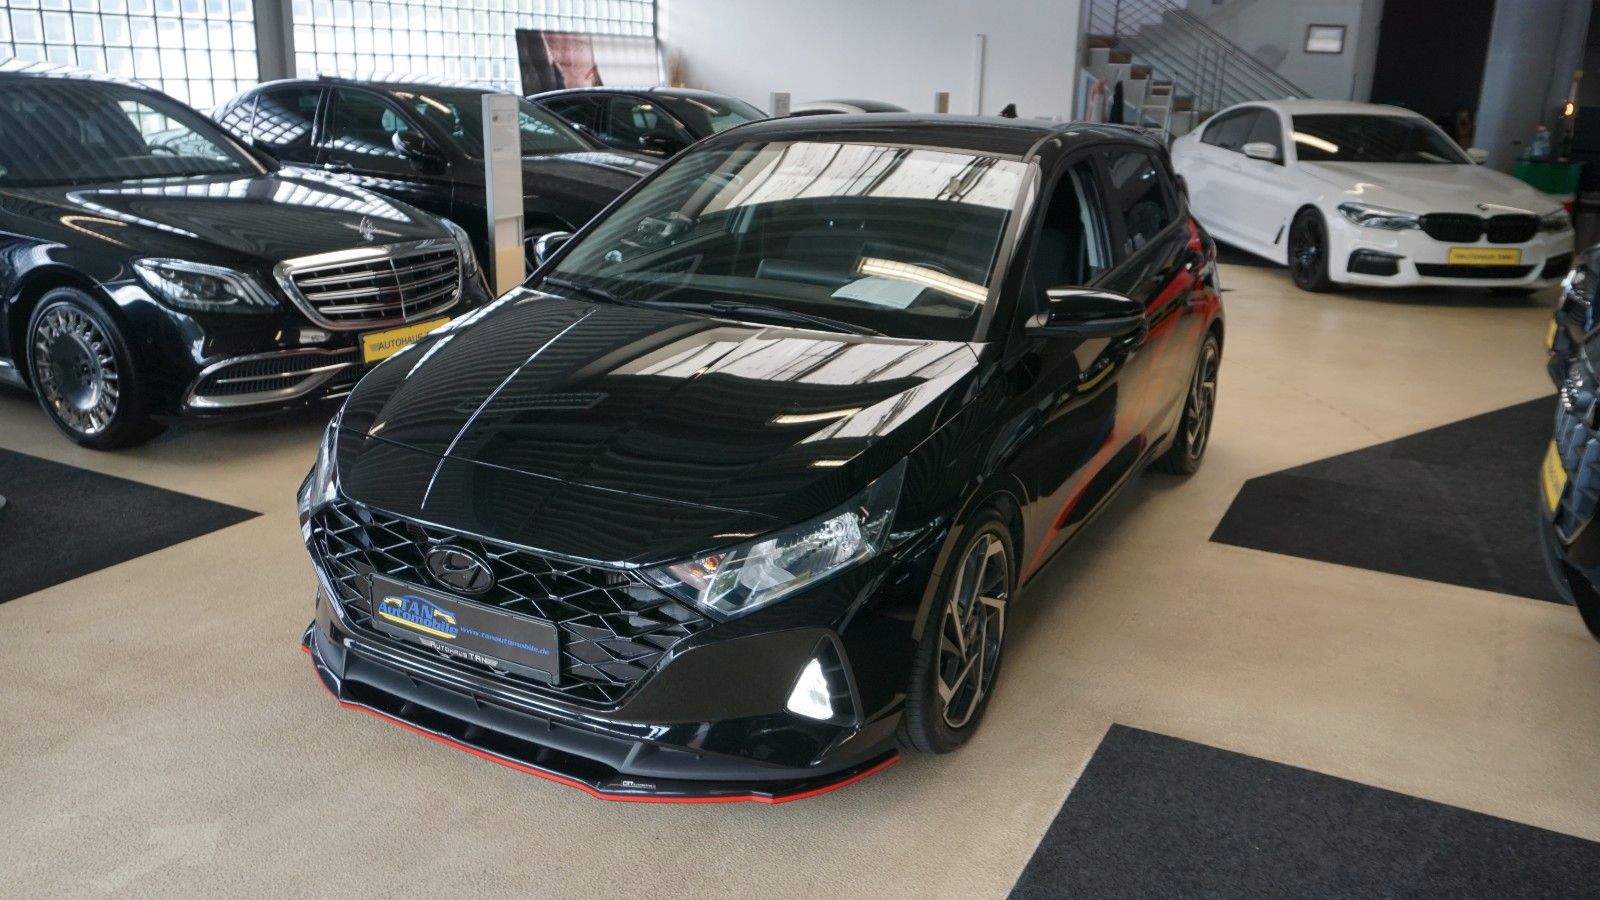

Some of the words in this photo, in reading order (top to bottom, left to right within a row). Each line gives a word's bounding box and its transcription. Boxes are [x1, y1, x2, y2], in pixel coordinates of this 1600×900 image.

[378, 601, 458, 635] Automobile
[401, 598, 434, 620] TAN
[460, 625, 550, 657] www.tanautomobile.de
